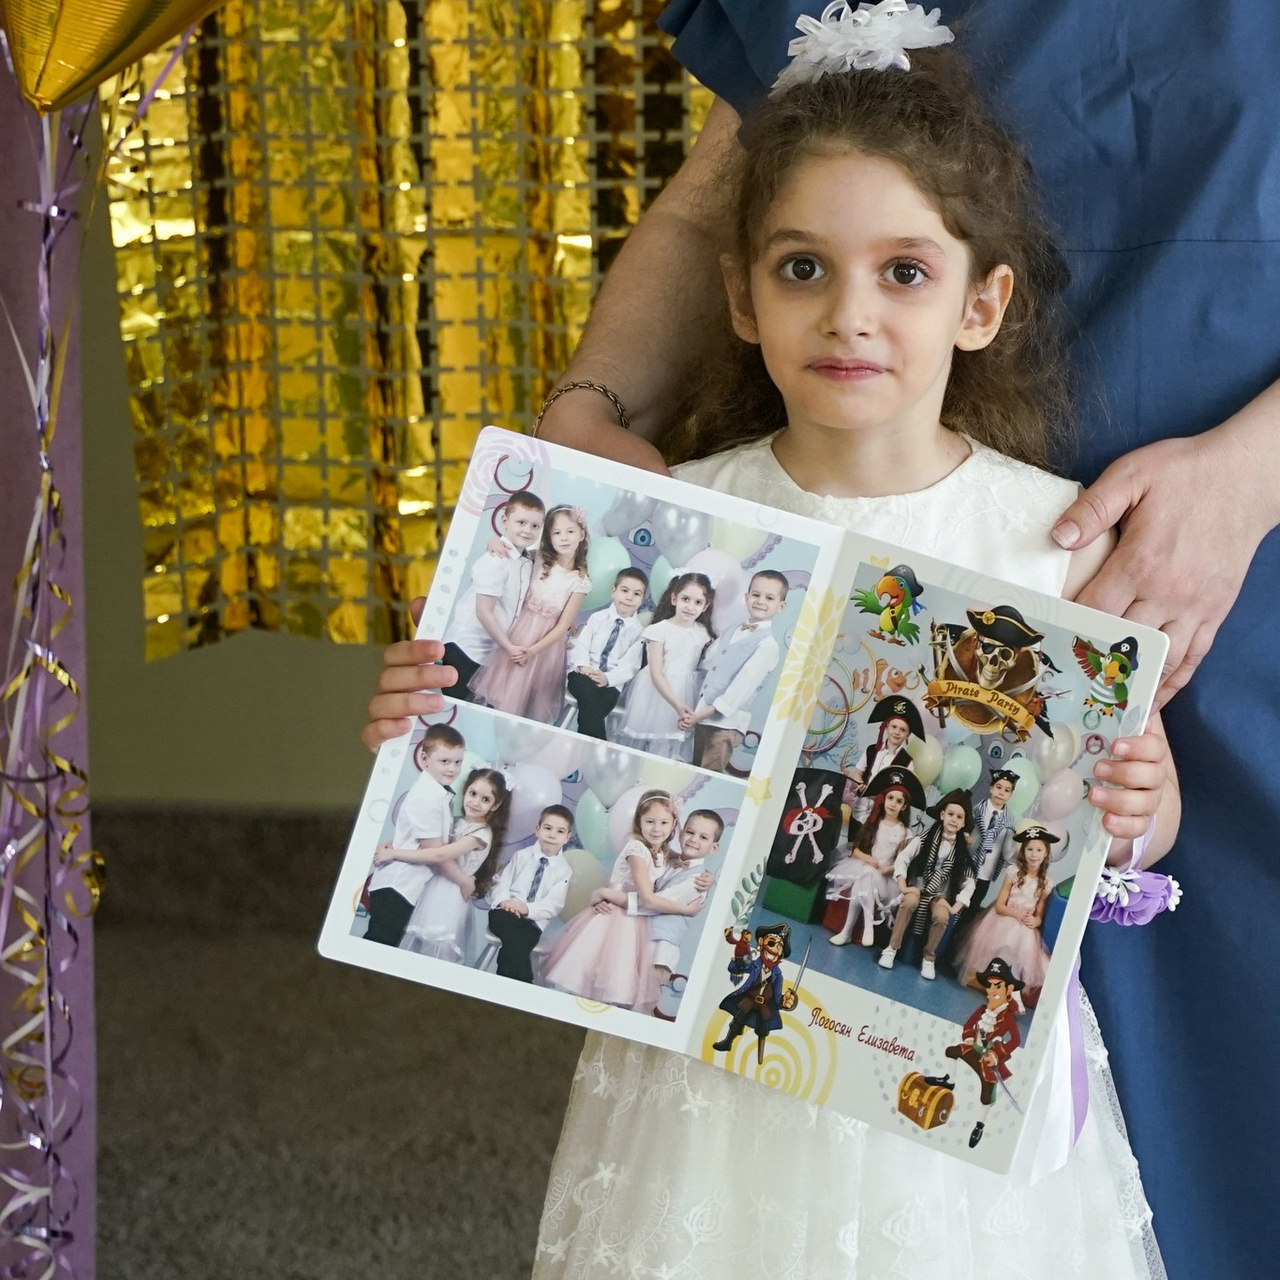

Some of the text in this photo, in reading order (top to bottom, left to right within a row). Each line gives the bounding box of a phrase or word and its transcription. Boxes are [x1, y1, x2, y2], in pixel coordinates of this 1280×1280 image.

[943, 682, 1021, 715] Pirate Party
[808, 1007, 916, 1061] Погосян Елизавета
